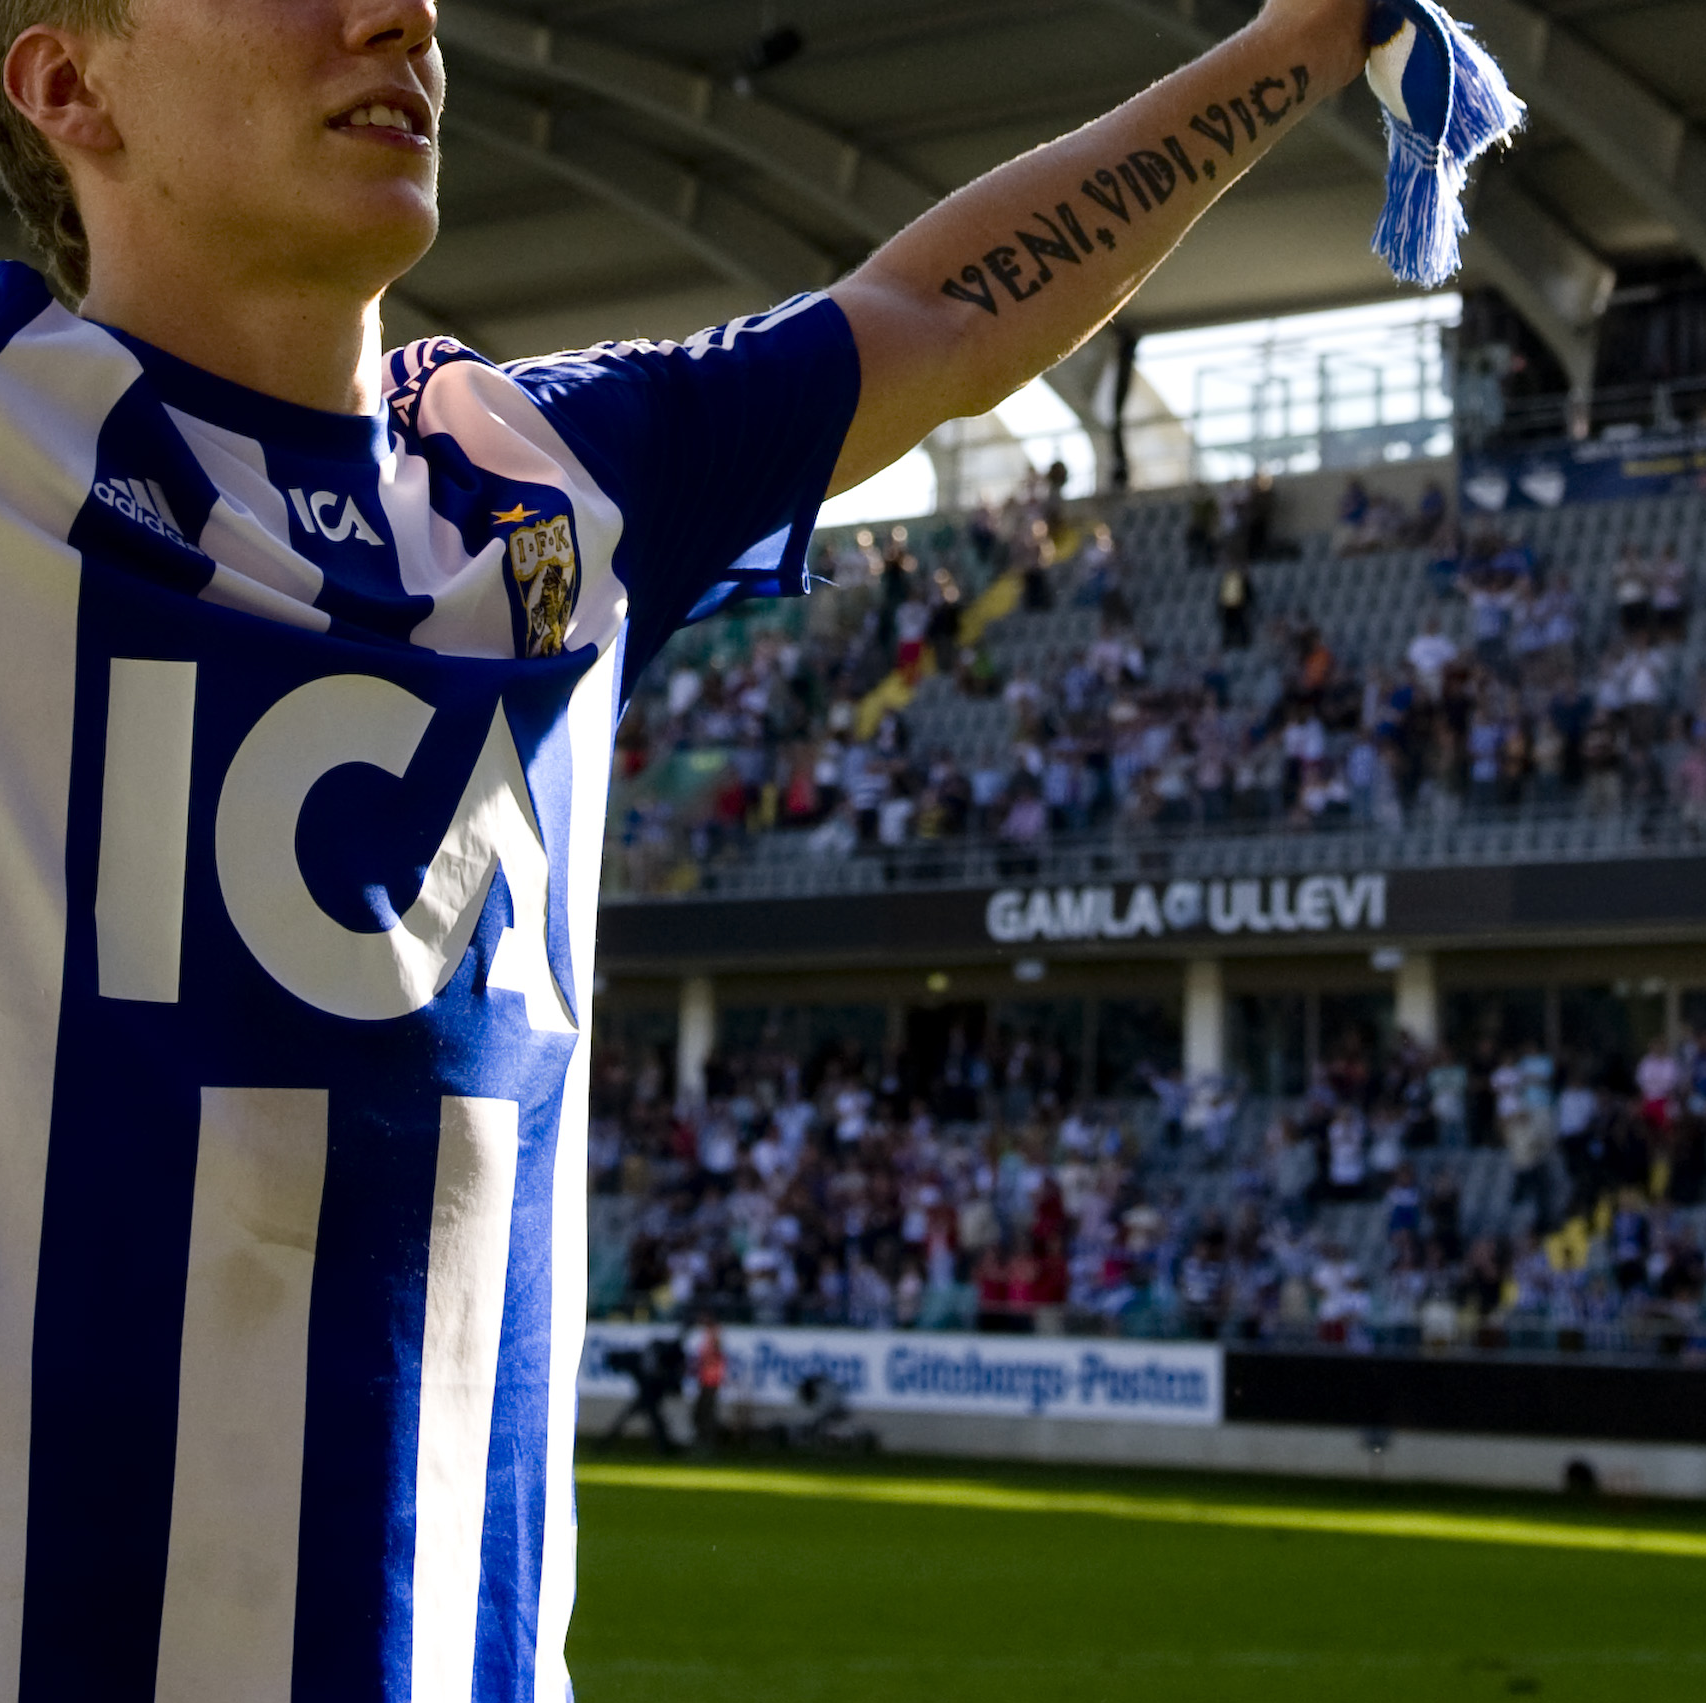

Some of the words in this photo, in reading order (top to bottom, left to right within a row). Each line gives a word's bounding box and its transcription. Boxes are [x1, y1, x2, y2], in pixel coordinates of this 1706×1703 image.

[1188, 64, 1310, 157] VICI
[288, 487, 384, 546] ICA
[95, 657, 579, 1032] ICA
[986, 882, 1164, 943] GAMLA
[1207, 872, 1386, 934] ULLEVI
